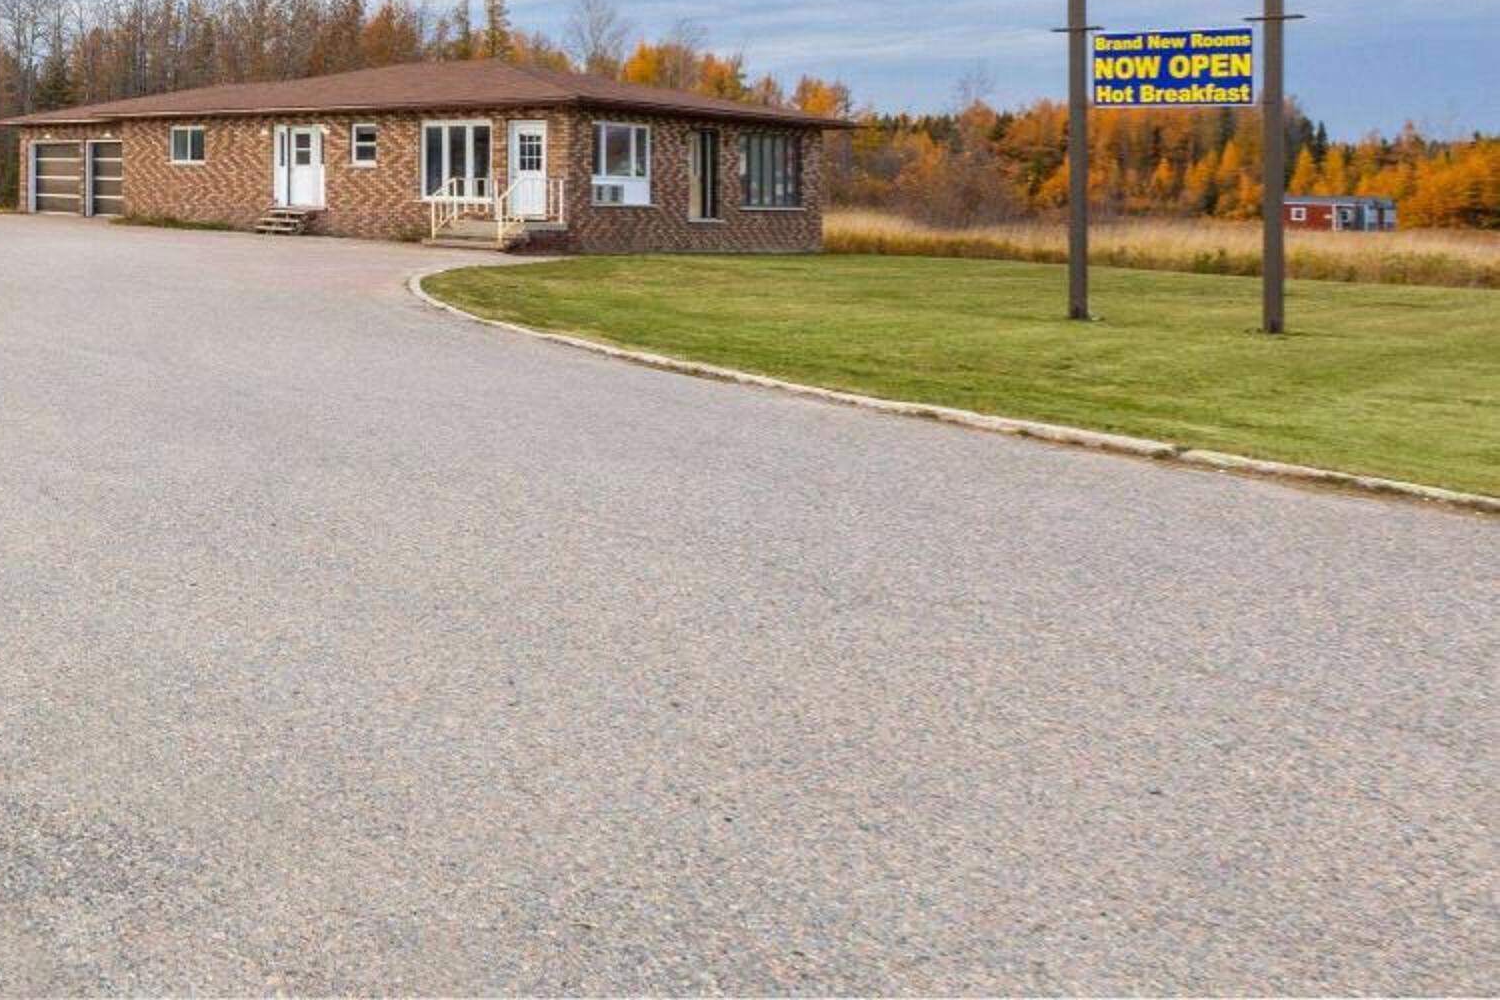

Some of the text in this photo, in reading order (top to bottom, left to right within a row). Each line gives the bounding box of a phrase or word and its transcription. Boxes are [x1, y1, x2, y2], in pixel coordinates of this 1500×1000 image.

[1095, 33, 1251, 51] Brand New Rooms
[1095, 53, 1252, 79] NOW OPEN
[1097, 84, 1251, 103] Hot Breakfast
